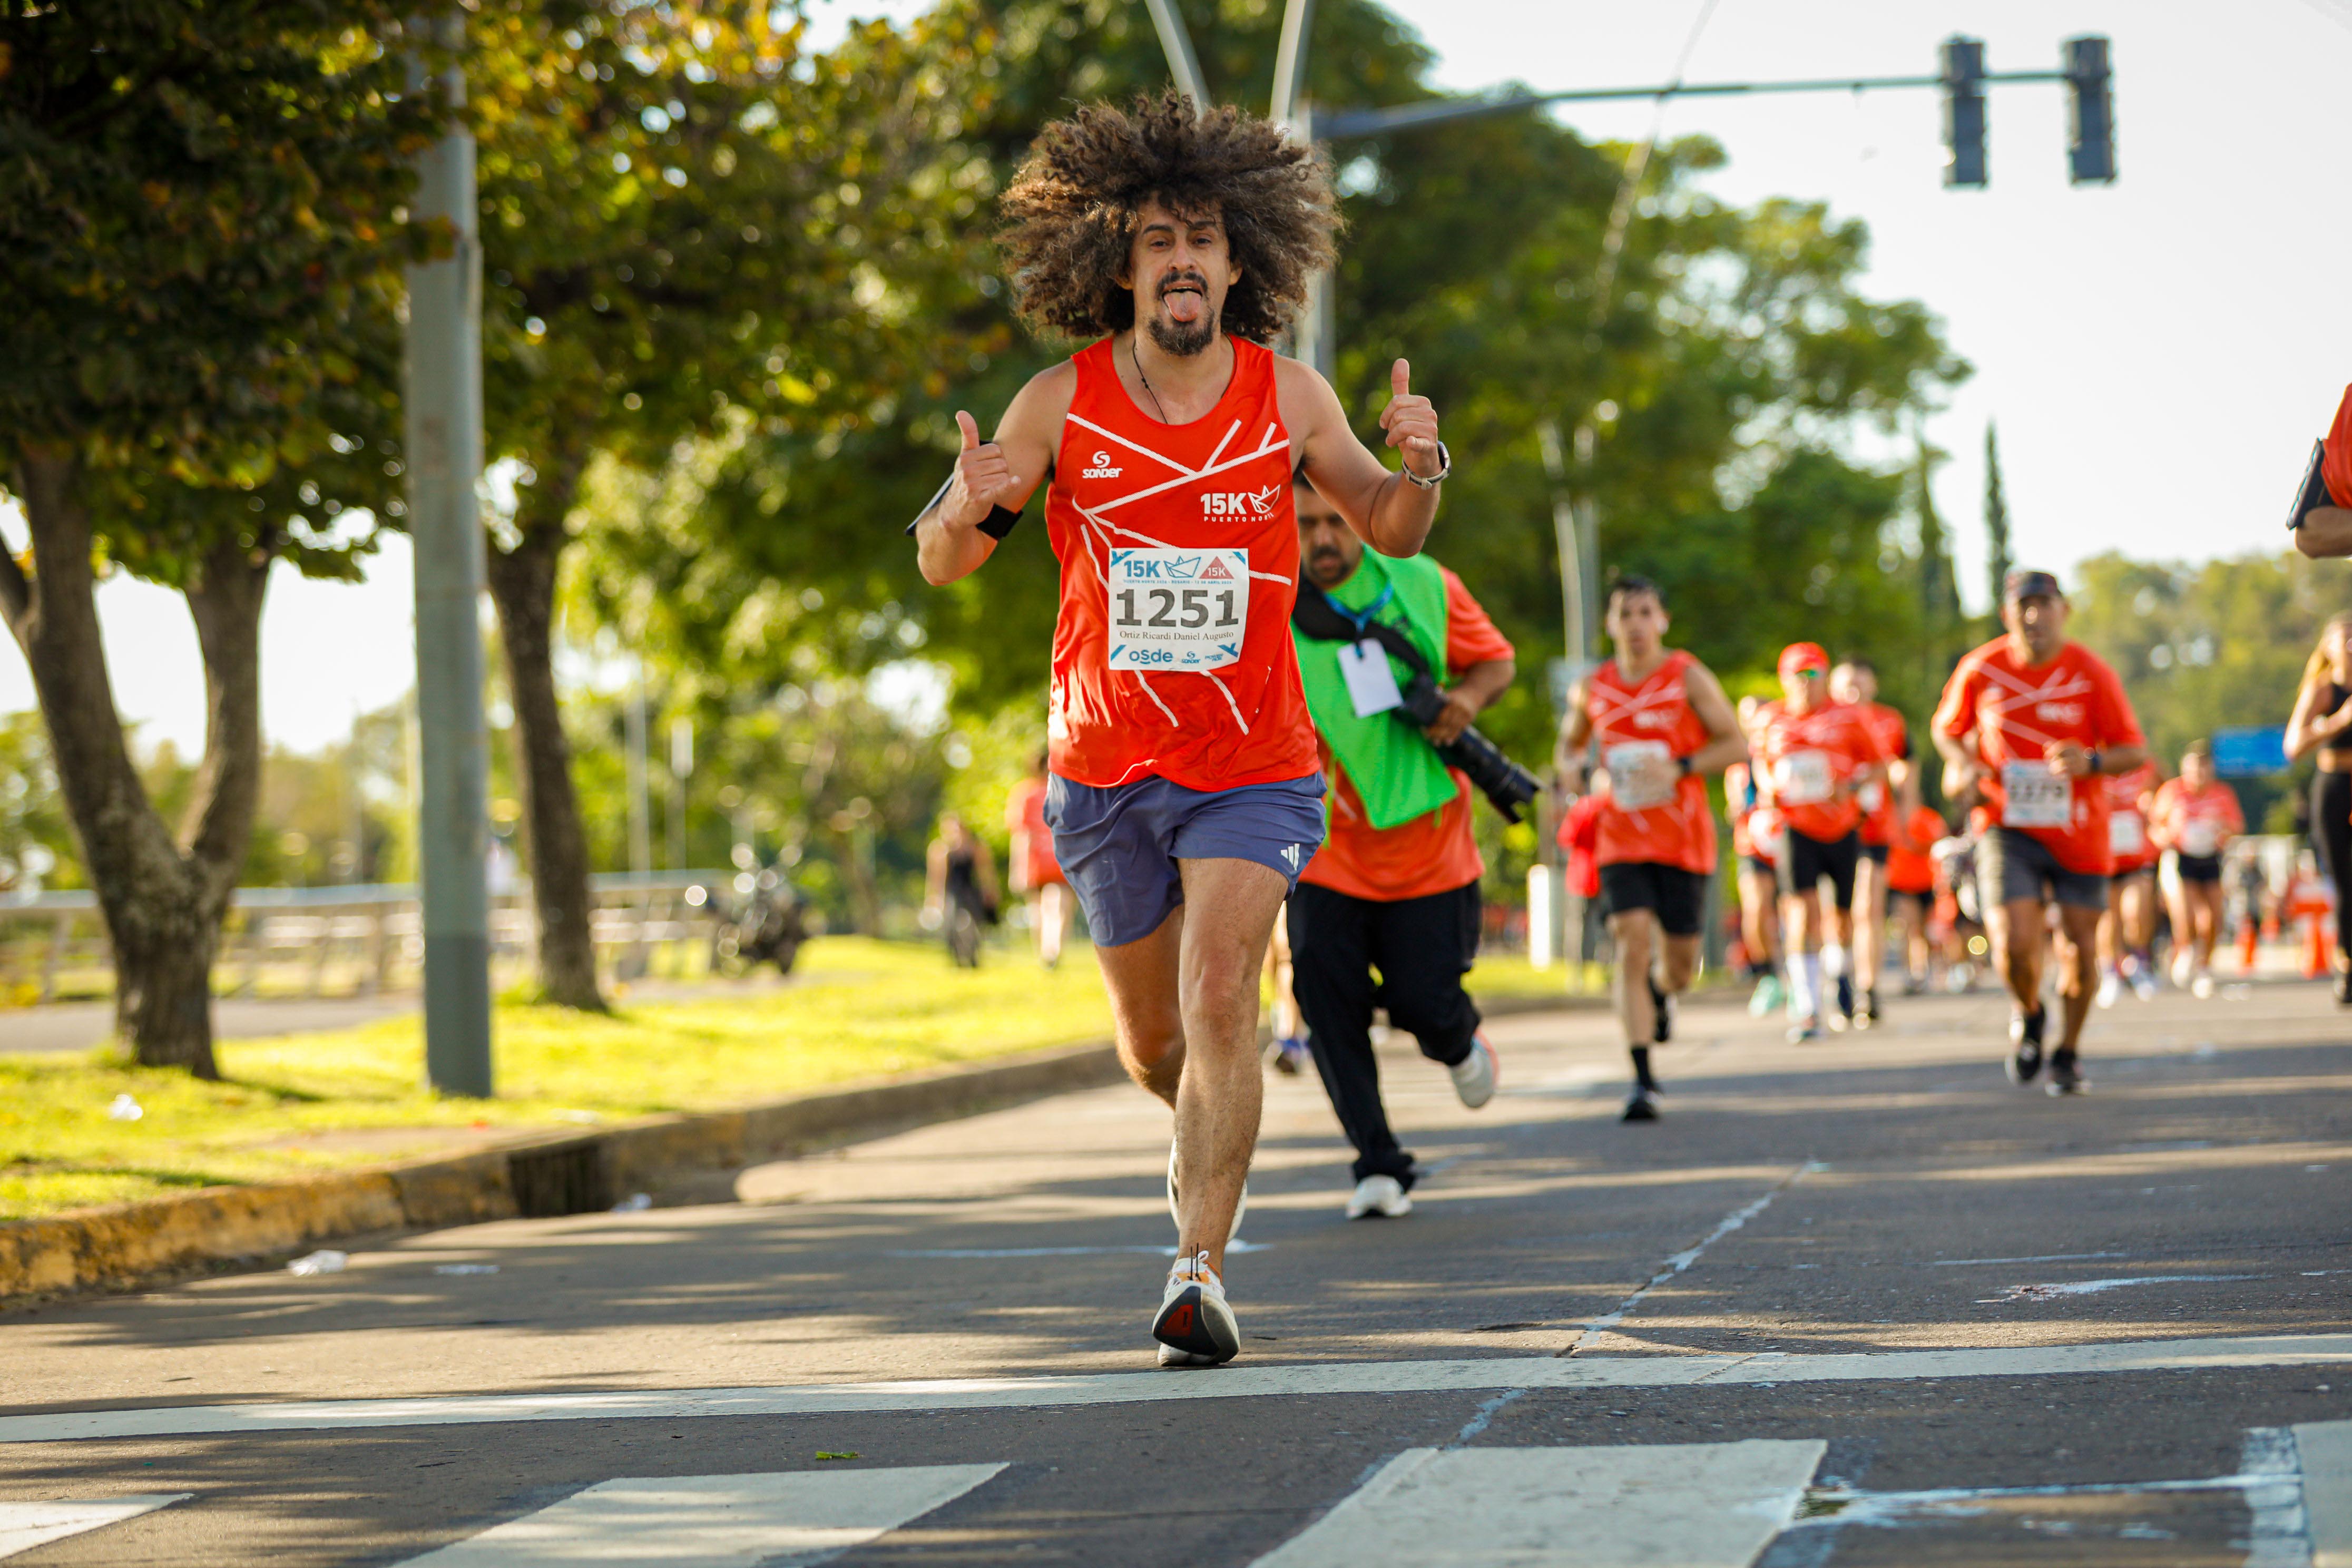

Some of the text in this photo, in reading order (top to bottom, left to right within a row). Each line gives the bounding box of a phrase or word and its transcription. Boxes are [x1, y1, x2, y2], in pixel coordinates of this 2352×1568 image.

[1201, 493, 1247, 514] 15K
[1124, 560, 1160, 577] 15K
[1208, 567, 1227, 576] 15K
[1116, 589, 1239, 628] 1251
[1202, 631, 1233, 641] Augusto
[1129, 648, 1173, 664] osde
